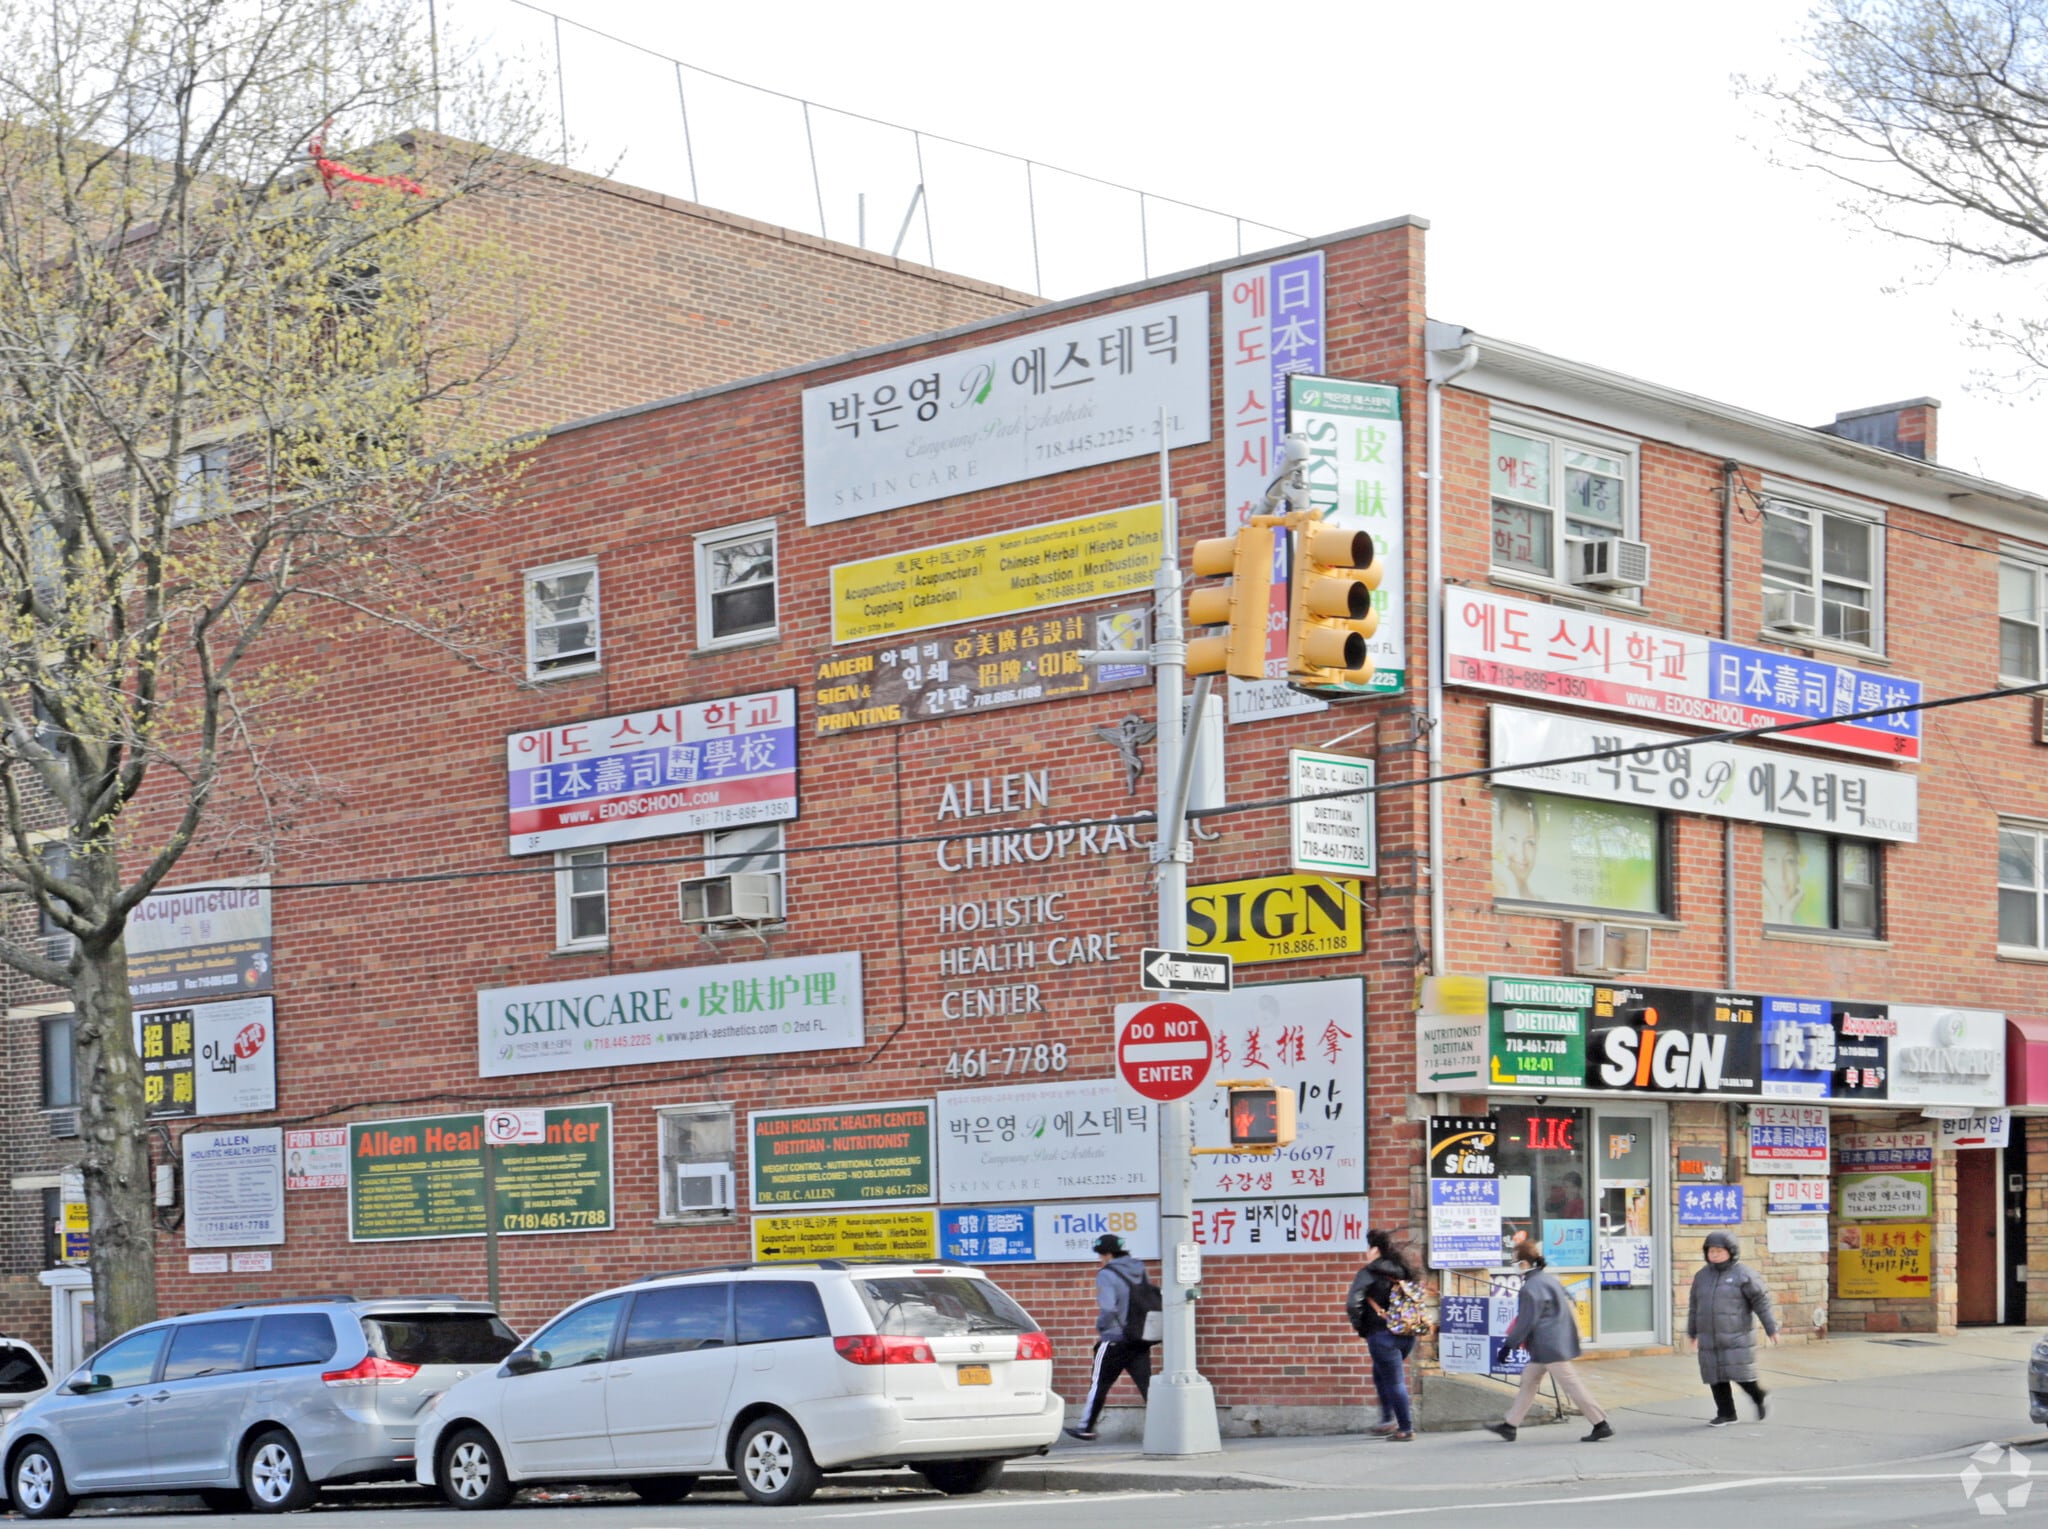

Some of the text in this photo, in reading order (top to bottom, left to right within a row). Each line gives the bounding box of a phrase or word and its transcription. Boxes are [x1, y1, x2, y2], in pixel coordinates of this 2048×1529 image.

[1233, 276, 1267, 366] 에도
[829, 315, 1178, 438] 박은영 에스테틱
[1035, 425, 1135, 461] 718.445.2225
[834, 459, 980, 507] SKIN CARE
[1000, 553, 1041, 571] Chinese
[1044, 545, 1080, 562] Herbal
[845, 579, 906, 601] Acupuncture
[1010, 568, 1074, 590] Moxibustion
[864, 600, 904, 618] Cupping
[1462, 602, 1688, 682] 에도 스시 학교
[817, 655, 874, 680] AMERI
[879, 642, 940, 668] 아메리
[901, 661, 950, 691] 인쇄
[817, 684, 872, 706] SIGN &
[925, 684, 971, 714] 간판
[518, 695, 782, 764] 에도 스시 학교
[817, 703, 901, 731] PRINTING
[1591, 735, 1868, 827] 박은영 에스테틱
[936, 769, 1049, 820] ALLEN
[1314, 806, 1353, 822] DIETITIAN
[1306, 822, 1360, 838] NUTRITIONIST
[1303, 840, 1365, 860] 718-461-7788
[133, 889, 261, 924] Acupunctura
[939, 892, 1066, 933] HOLISTIC
[1186, 880, 1351, 946] SIGN
[940, 932, 1121, 976] HEALTH CARE
[1269, 936, 1348, 955] 718.886.1188
[1157, 963, 1217, 980] ONE WAY
[698, 971, 837, 1017] 皮肤护理
[941, 984, 1043, 1020] CENTER
[1503, 983, 1594, 1006] NUTRITIONIST
[503, 987, 673, 1036] SKINCARE
[1516, 1012, 1578, 1033] DIETITIAN
[593, 1033, 652, 1050] 718.445.2225
[793, 1019, 811, 1034] 2nd
[1131, 1020, 1199, 1039] DO NOT
[1424, 1025, 1481, 1041] NUTRITIONIST
[1433, 1041, 1473, 1055] DIETITIAN
[1506, 1038, 1567, 1054] 718-461-7788
[945, 1043, 1069, 1079] 461-7788
[1517, 1056, 1553, 1071] 142-01
[1138, 1065, 1193, 1083] ENTER
[756, 1111, 927, 1136] ALLEN HOLISTIC HEALTH CENTER
[949, 1105, 1147, 1144] 박은영 에스테틱
[1943, 1115, 2003, 1135] 한미지압
[213, 1135, 249, 1148] ALLEN
[290, 1131, 345, 1147] FOR RENT
[357, 1130, 418, 1158] Allen
[546, 1118, 600, 1144] nter
[773, 1133, 911, 1156] DIETITIAN NUTRITIONIST
[804, 1188, 836, 1200] ALLEN
[885, 1184, 929, 1196] 461-7788
[949, 1181, 991, 1193] SKIN
[996, 1178, 1042, 1192] CARE
[1057, 1173, 1117, 1187] 718.445.2225
[1216, 1167, 1326, 1192] 수강생 모집
[1053, 1211, 1138, 1234] iTalkBB
[1245, 1203, 1298, 1244] 발지압
[1446, 1304, 1484, 1323] 充值
[1446, 1342, 1482, 1361] 上网
